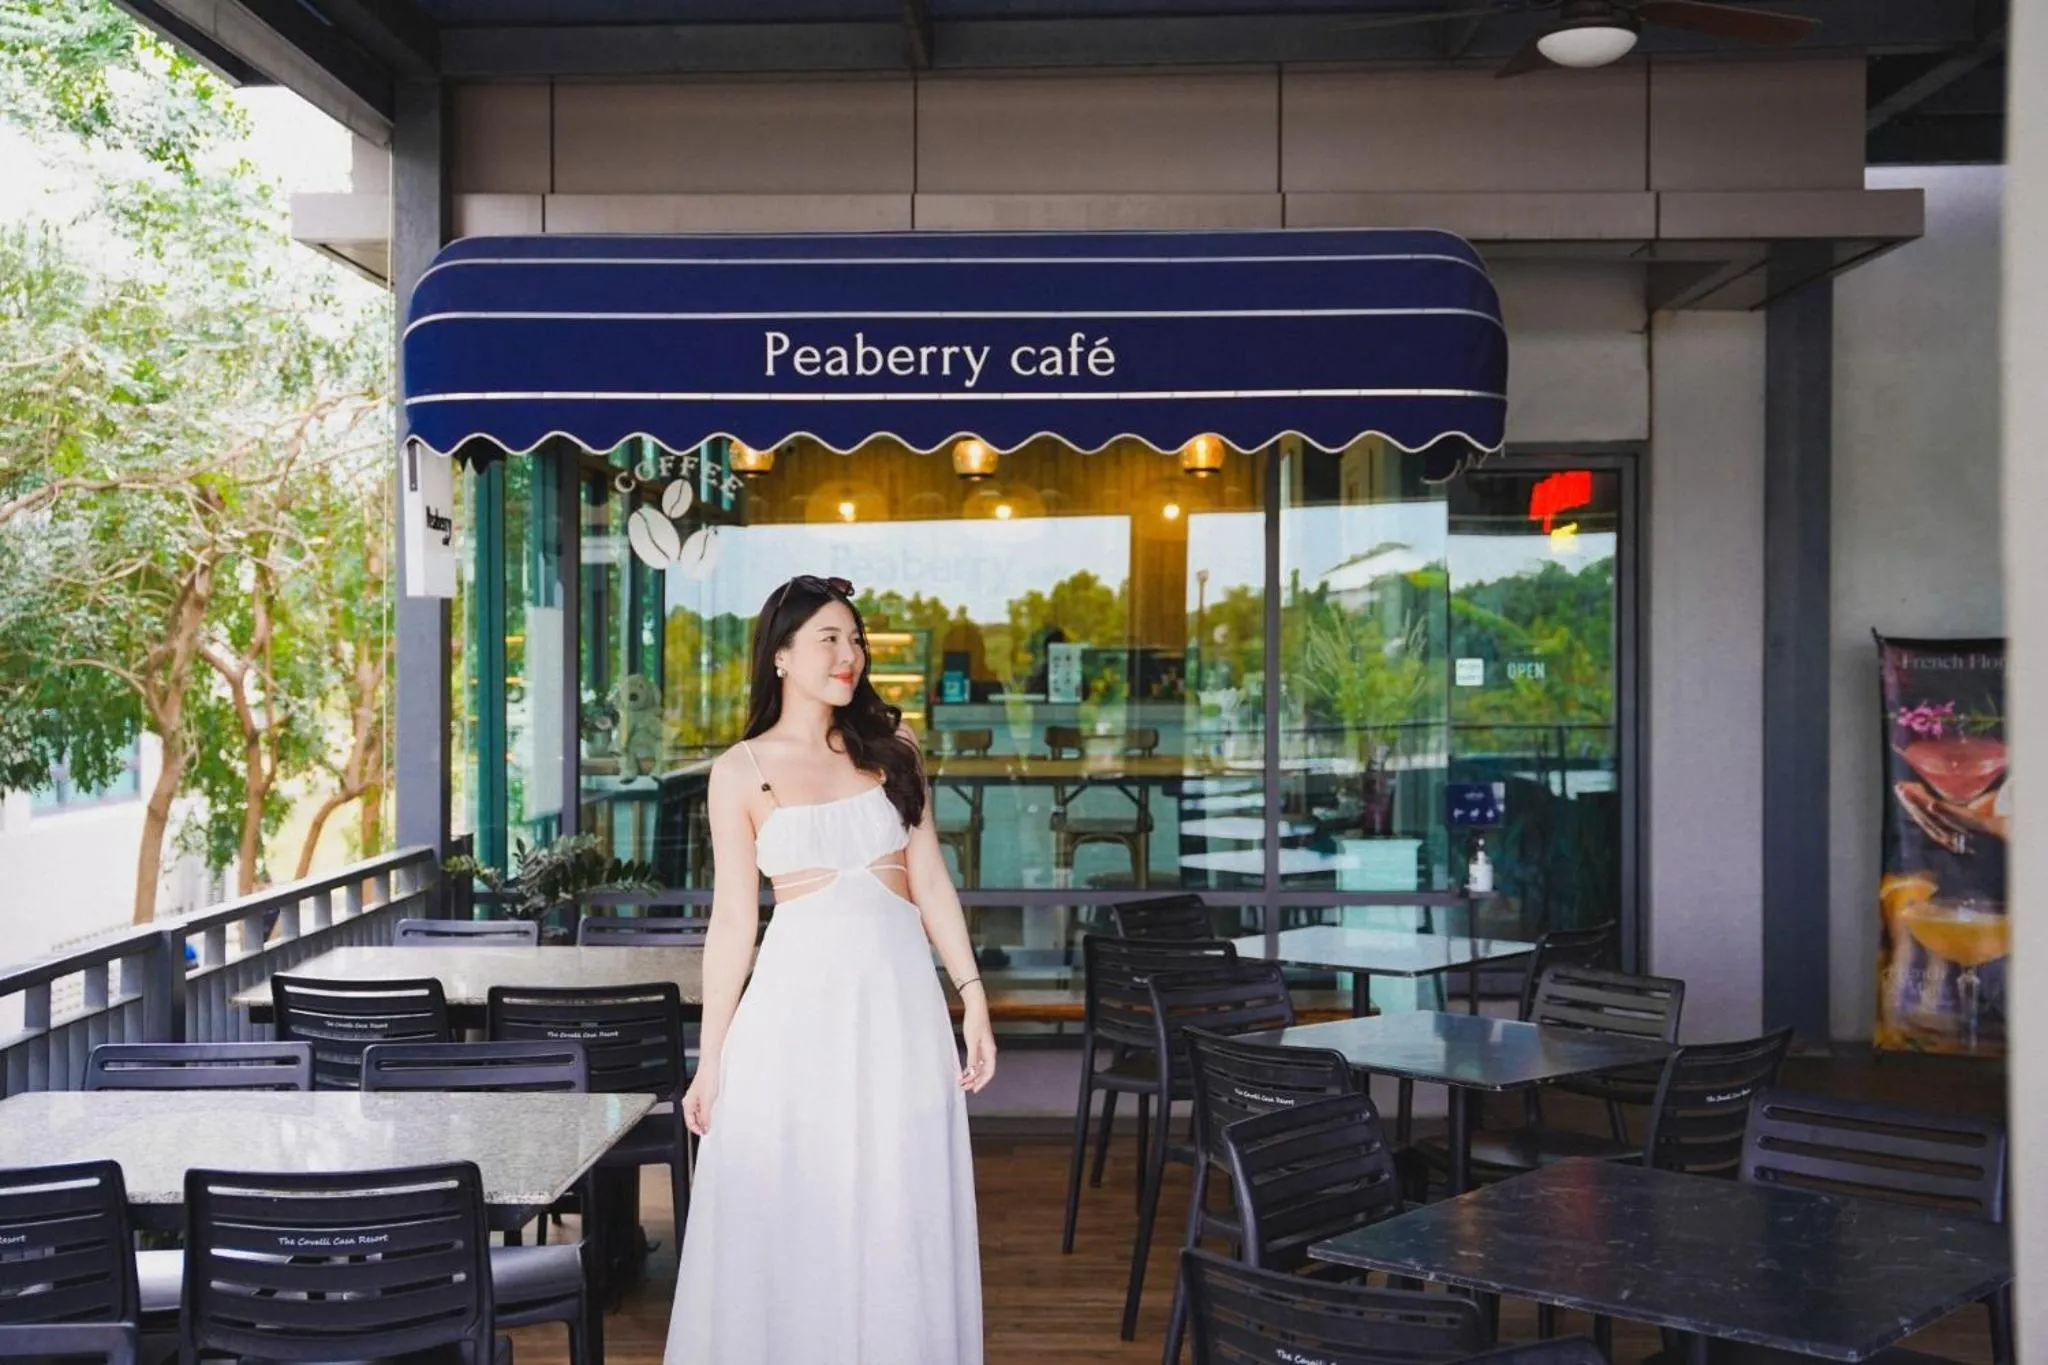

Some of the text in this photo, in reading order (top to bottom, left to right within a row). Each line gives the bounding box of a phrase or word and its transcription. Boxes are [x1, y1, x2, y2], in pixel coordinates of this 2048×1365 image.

[765, 332, 1116, 387] Peaberry café
[613, 455, 744, 501] COFFEE
[1506, 661, 1546, 680] OPEN
[1901, 653, 1964, 670] French
[278, 1236, 295, 1246] The
[358, 1233, 389, 1245] Resort
